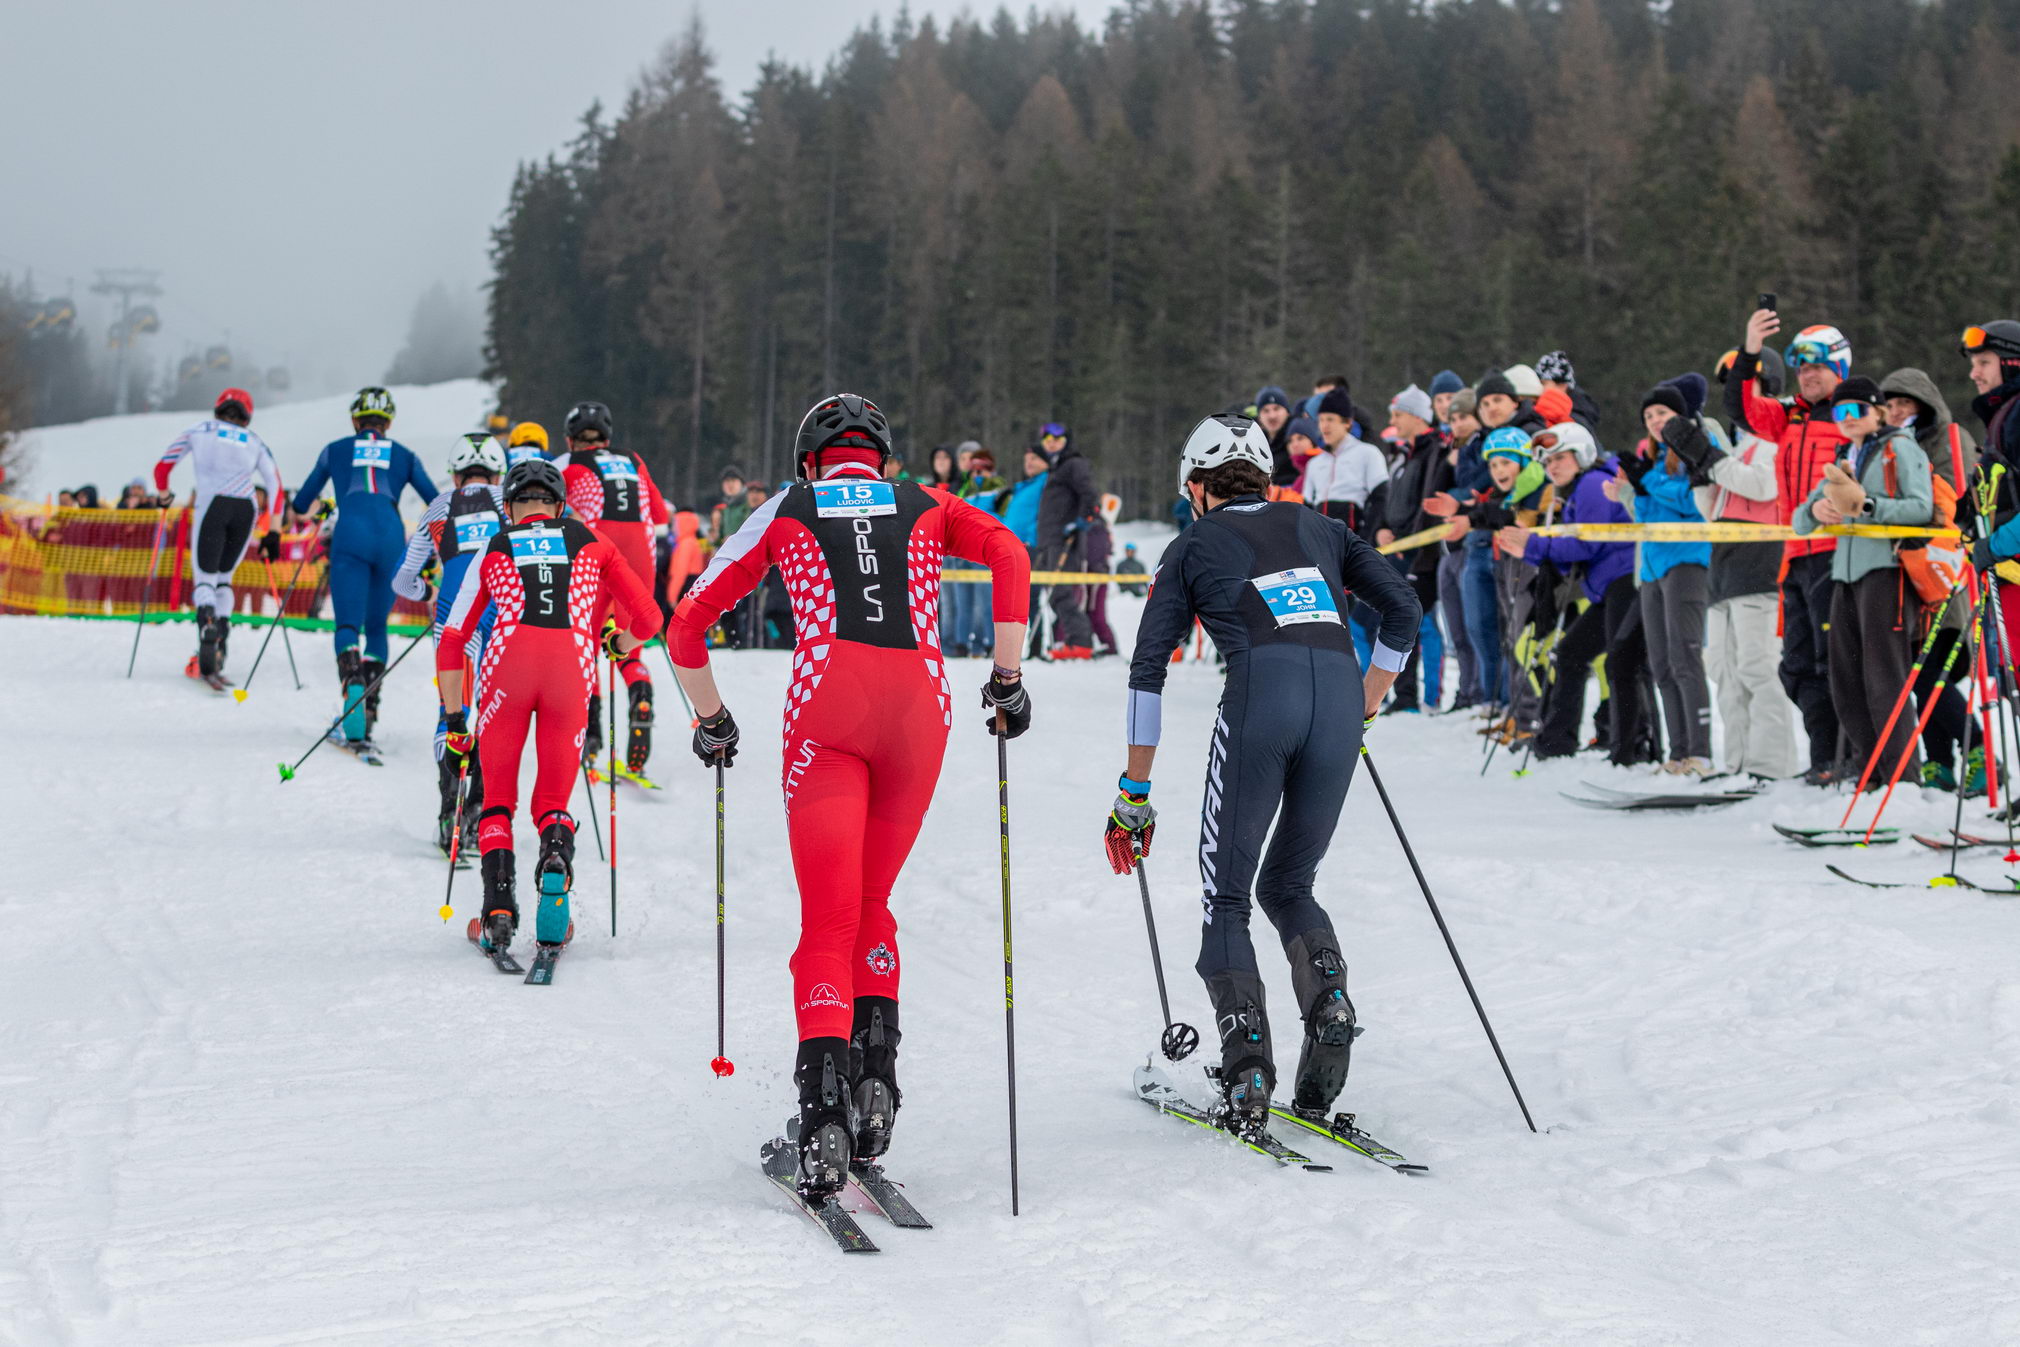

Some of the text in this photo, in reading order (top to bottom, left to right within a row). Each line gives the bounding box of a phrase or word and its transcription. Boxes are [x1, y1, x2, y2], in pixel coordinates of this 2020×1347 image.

[836, 485, 873, 500] 15
[837, 498, 875, 506] LUDOVIC
[467, 523, 489, 537] 37
[526, 539, 552, 551] 14
[539, 589, 554, 615] LA
[863, 583, 884, 622] LA
[1281, 586, 1317, 607] 29
[1296, 603, 1317, 611] JOHN
[1114, 799, 1138, 814] LEKI
[800, 1000, 850, 1010] LA SPORTIVA
